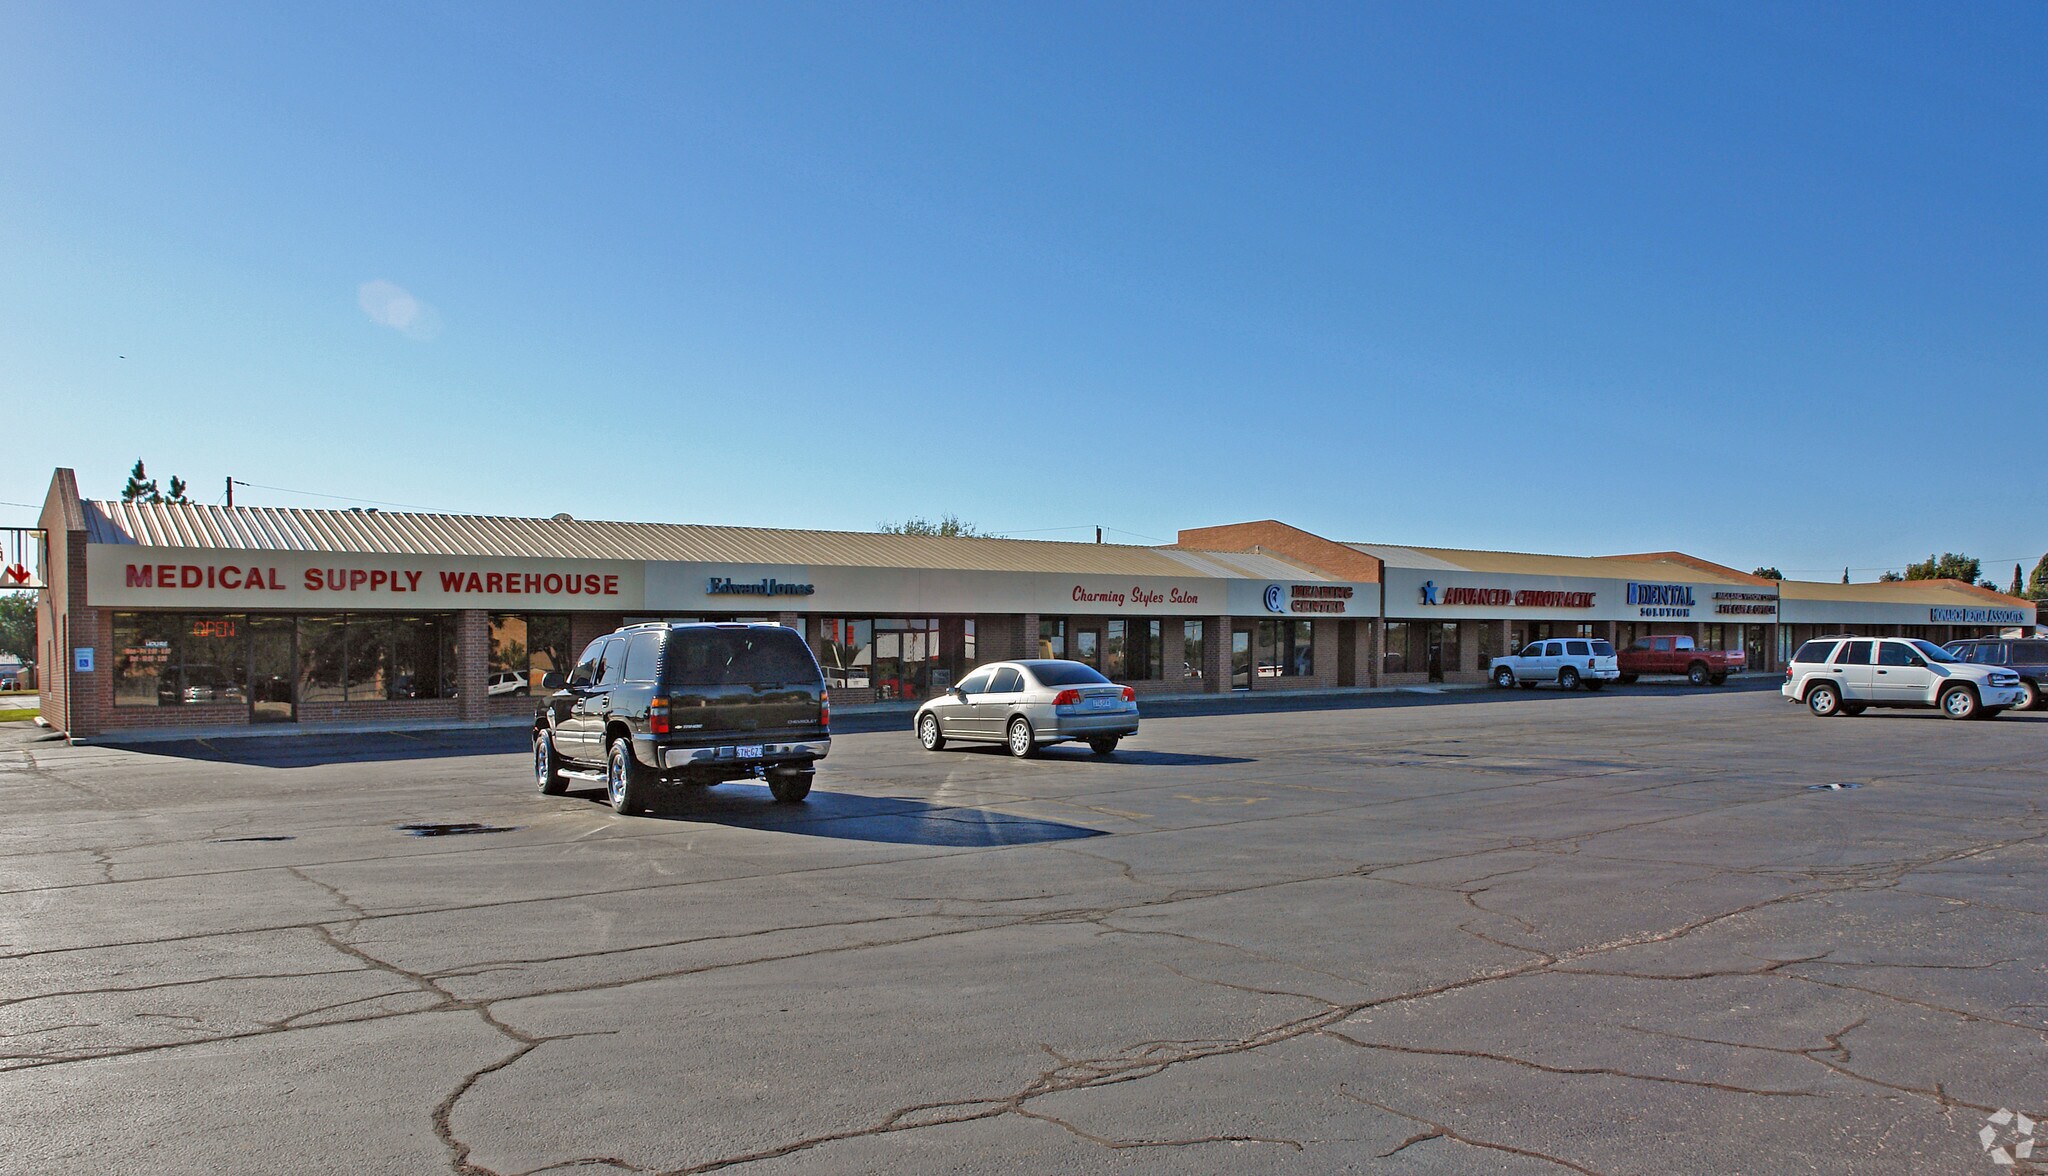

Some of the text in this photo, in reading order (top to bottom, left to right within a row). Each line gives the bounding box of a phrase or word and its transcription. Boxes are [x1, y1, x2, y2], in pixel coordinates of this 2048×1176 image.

[125, 564, 620, 595] MEDICAL SUPPLY WAREHOUSE
[1072, 585, 1198, 608] Charming Styles Salon
[1291, 585, 1354, 600] HEARING
[1443, 587, 1597, 608] ADVANCED CHIROPRACTIC
[1637, 584, 1696, 606] DENTAL
[1291, 600, 1346, 613] CENTER
[1640, 607, 1690, 617] SOLUTION
[193, 621, 236, 637] OPEN
